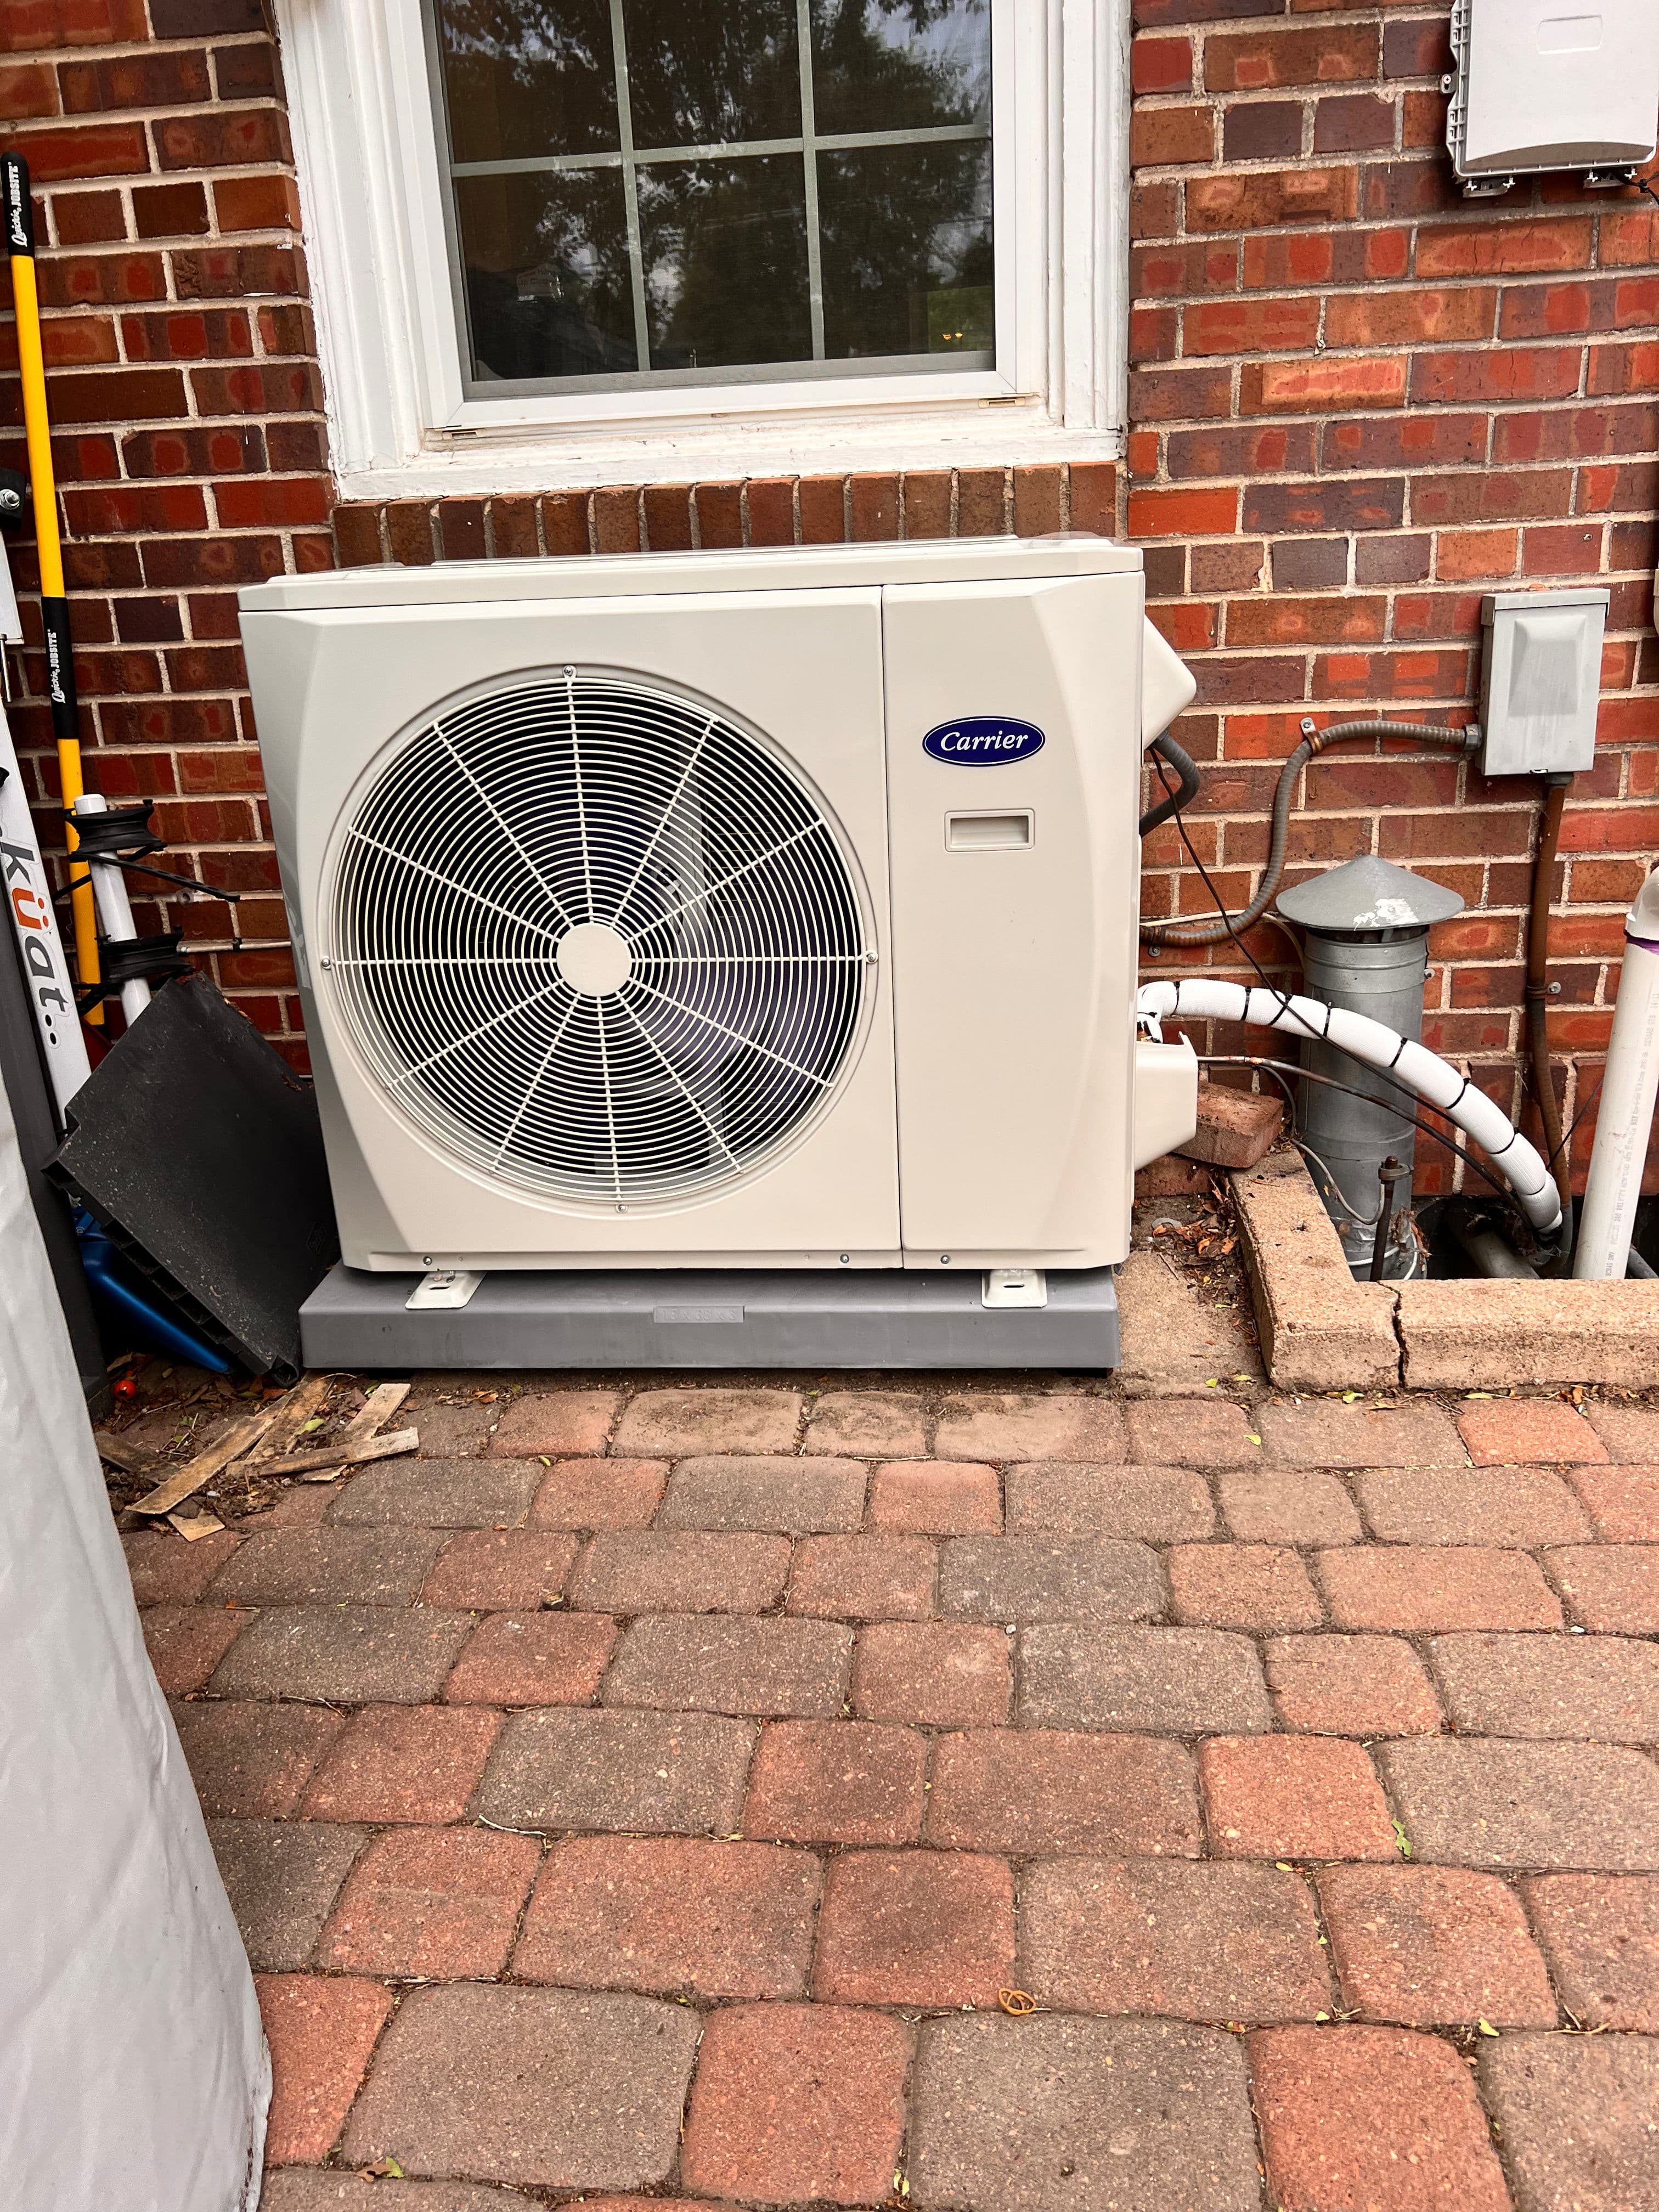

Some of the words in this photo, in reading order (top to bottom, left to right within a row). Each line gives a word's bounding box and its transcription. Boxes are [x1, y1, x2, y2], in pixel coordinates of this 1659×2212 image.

[9, 166, 21, 207] JOBSITE
[48, 632, 60, 668] JOBSITE
[940, 730, 1029, 751] Carrier
